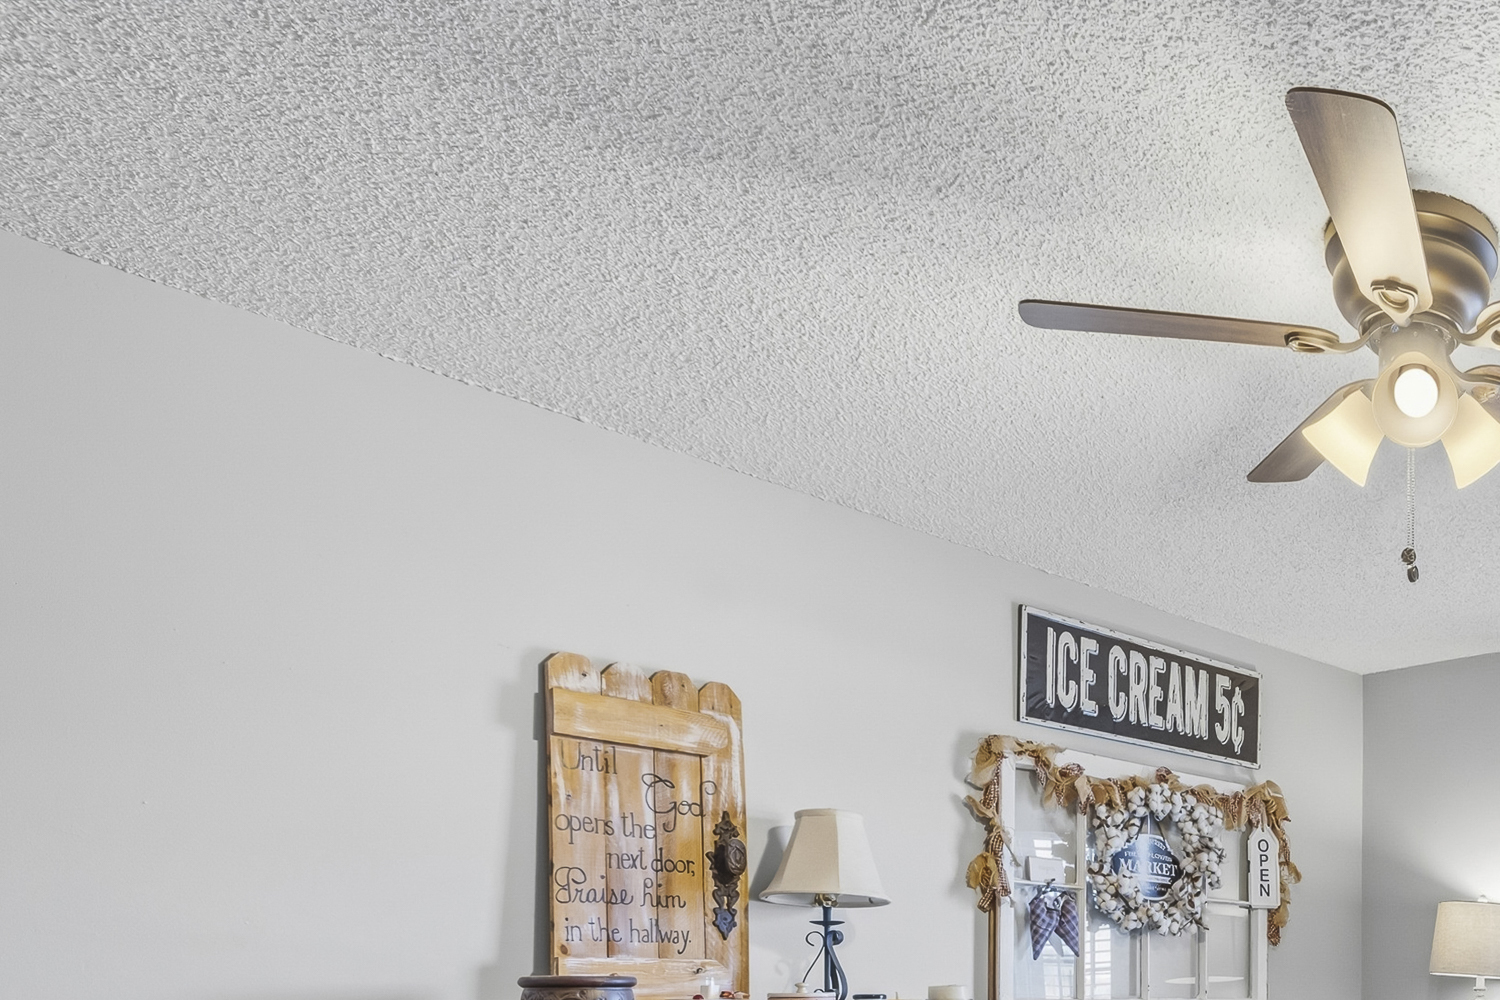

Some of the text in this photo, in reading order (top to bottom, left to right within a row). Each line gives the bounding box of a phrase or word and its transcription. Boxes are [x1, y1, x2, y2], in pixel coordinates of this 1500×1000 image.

[1046, 627, 1245, 755] ICE CREAM 5¢
[560, 739, 618, 775] Until
[641, 773, 717, 833] God
[555, 812, 657, 844] opens the
[607, 847, 696, 877] next door,
[1119, 858, 1177, 877] MARKET
[1257, 838, 1271, 897] OPEN
[555, 866, 687, 909] Praise him
[565, 917, 692, 955] in the hallway.
